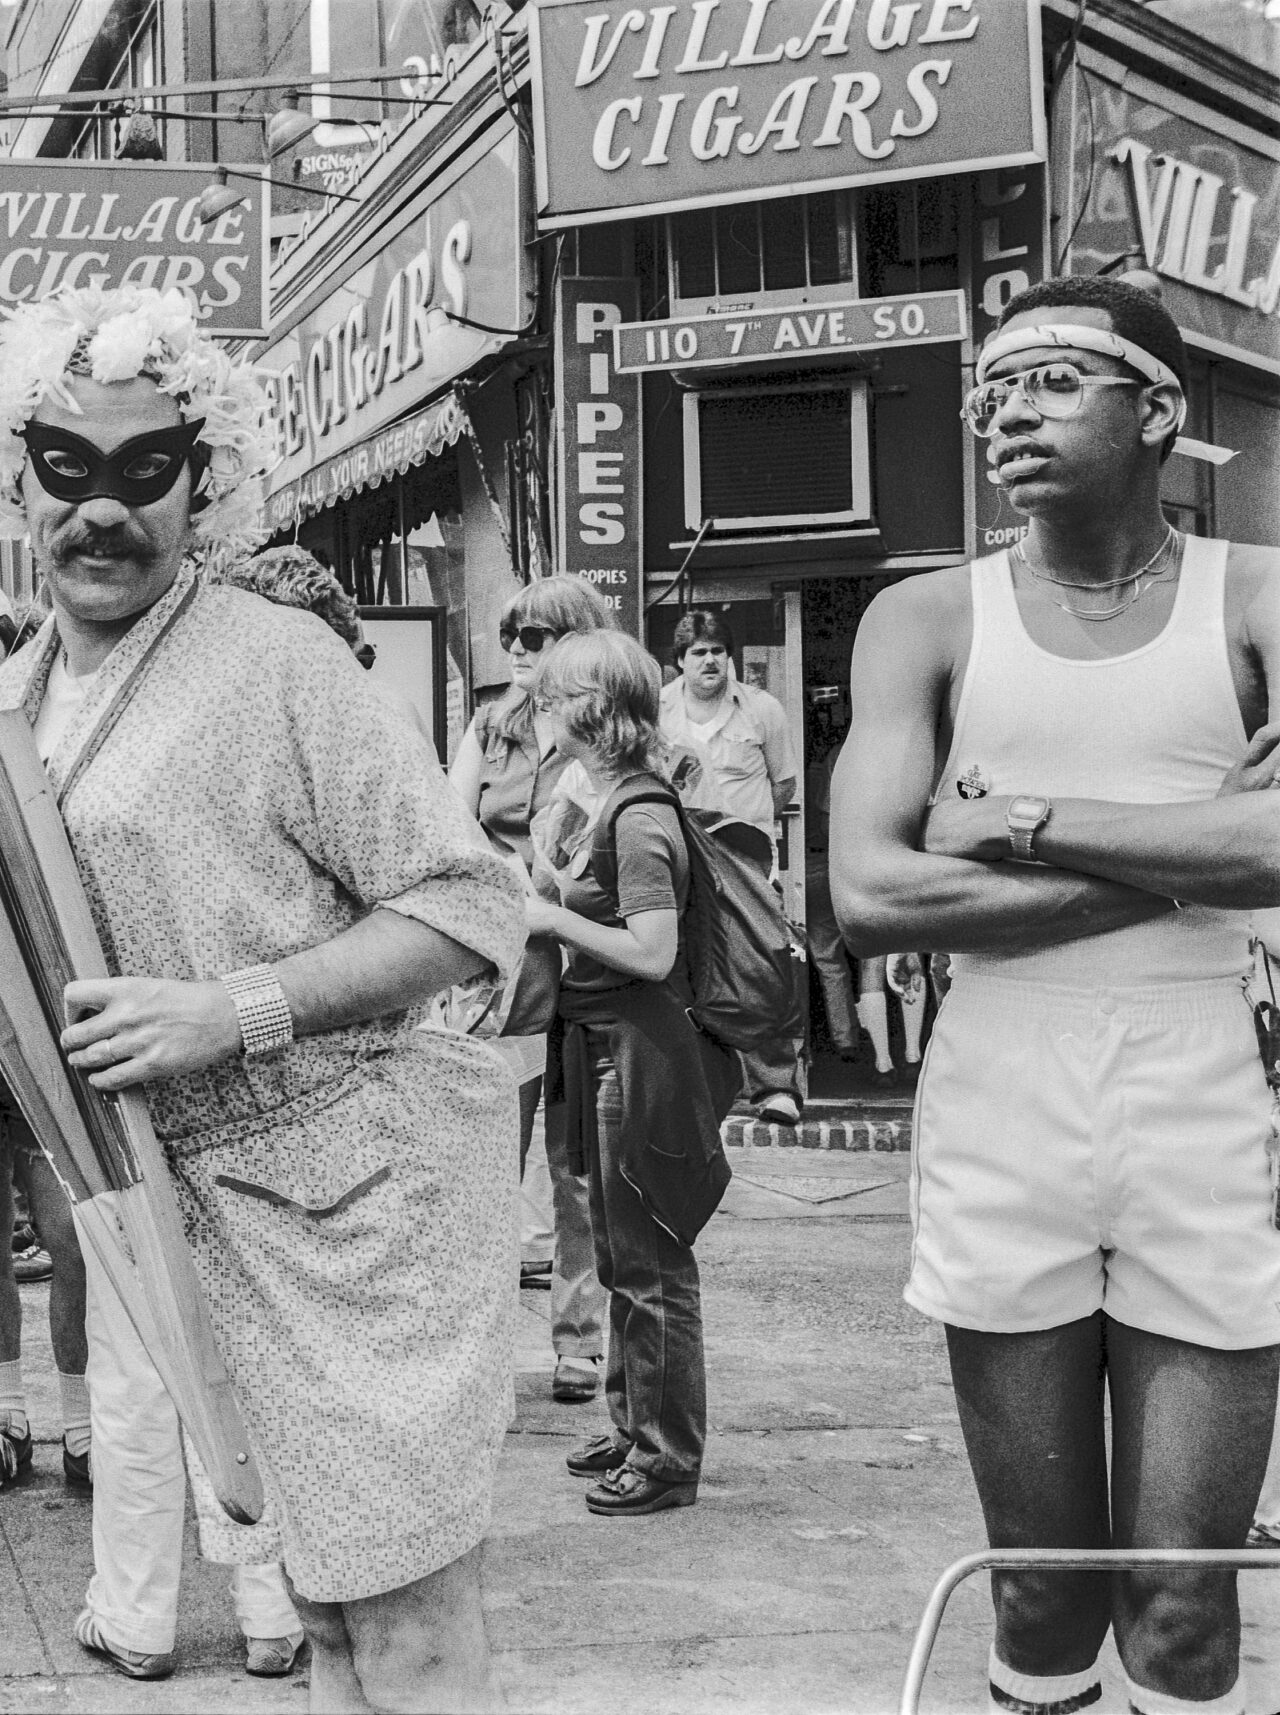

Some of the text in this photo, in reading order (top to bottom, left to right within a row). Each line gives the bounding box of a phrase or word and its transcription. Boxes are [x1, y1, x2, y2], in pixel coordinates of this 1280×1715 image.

[574, 0, 980, 88] VILLAGE
[591, 59, 953, 171] CIGARS
[1104, 137, 1280, 316] VILL
[645, 326, 698, 363] 110
[773, 311, 854, 350] AVE.
[873, 303, 931, 340] SO.
[575, 302, 626, 546] PIPES
[330, 450, 370, 493] YOUR
[984, 525, 1028, 546] COPIE
